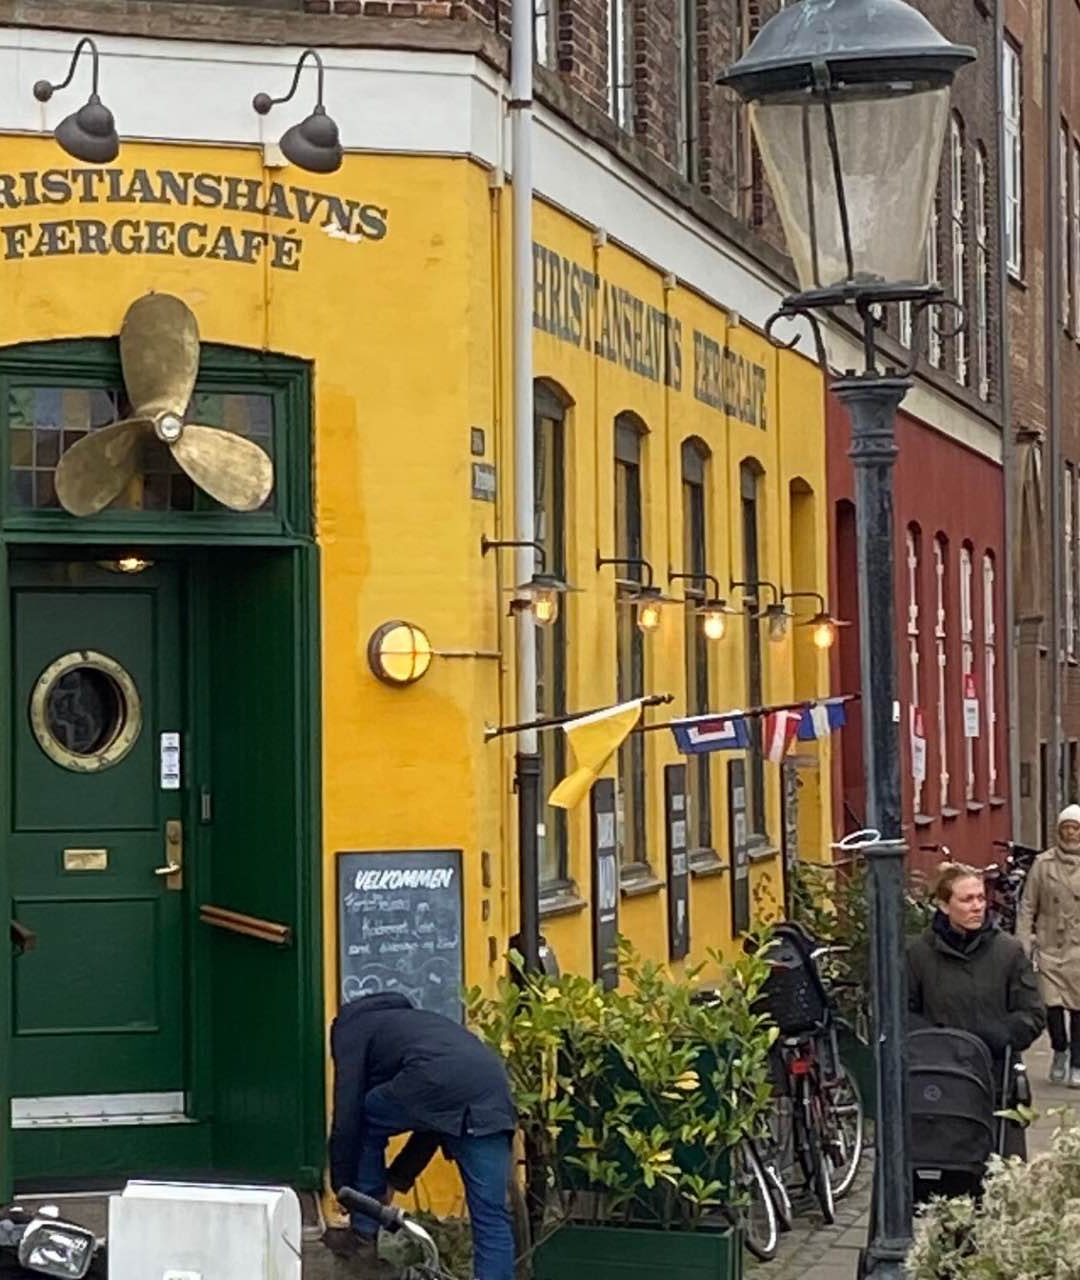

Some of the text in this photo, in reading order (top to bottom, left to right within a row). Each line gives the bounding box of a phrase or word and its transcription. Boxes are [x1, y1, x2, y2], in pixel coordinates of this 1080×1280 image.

[1, 218, 303, 271] FÆRGECAFÉ
[532, 240, 682, 391] HRISTANSHAVNS
[354, 867, 454, 891] VELKOMMEN
